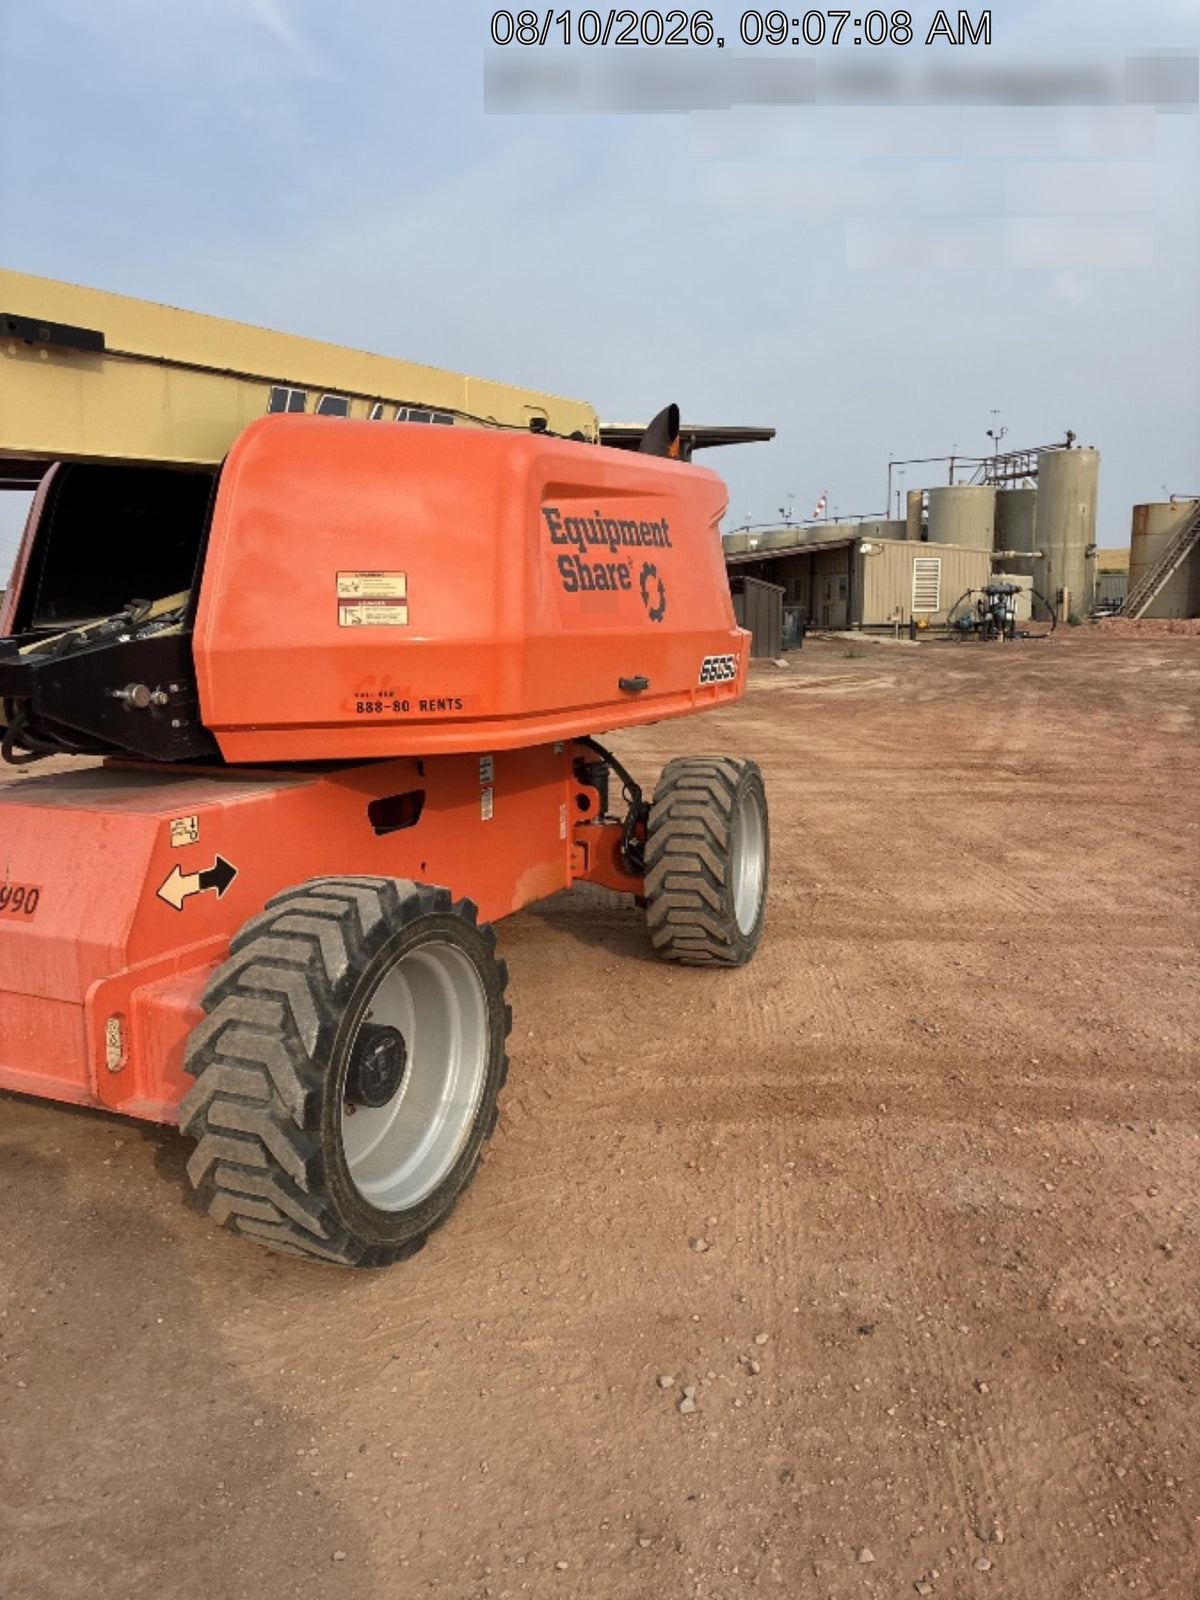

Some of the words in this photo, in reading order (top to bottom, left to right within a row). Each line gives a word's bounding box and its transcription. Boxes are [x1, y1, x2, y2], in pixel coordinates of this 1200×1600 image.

[542, 507, 672, 553] Equipment
[557, 554, 632, 592] Share
[419, 698, 463, 712] RENTS
